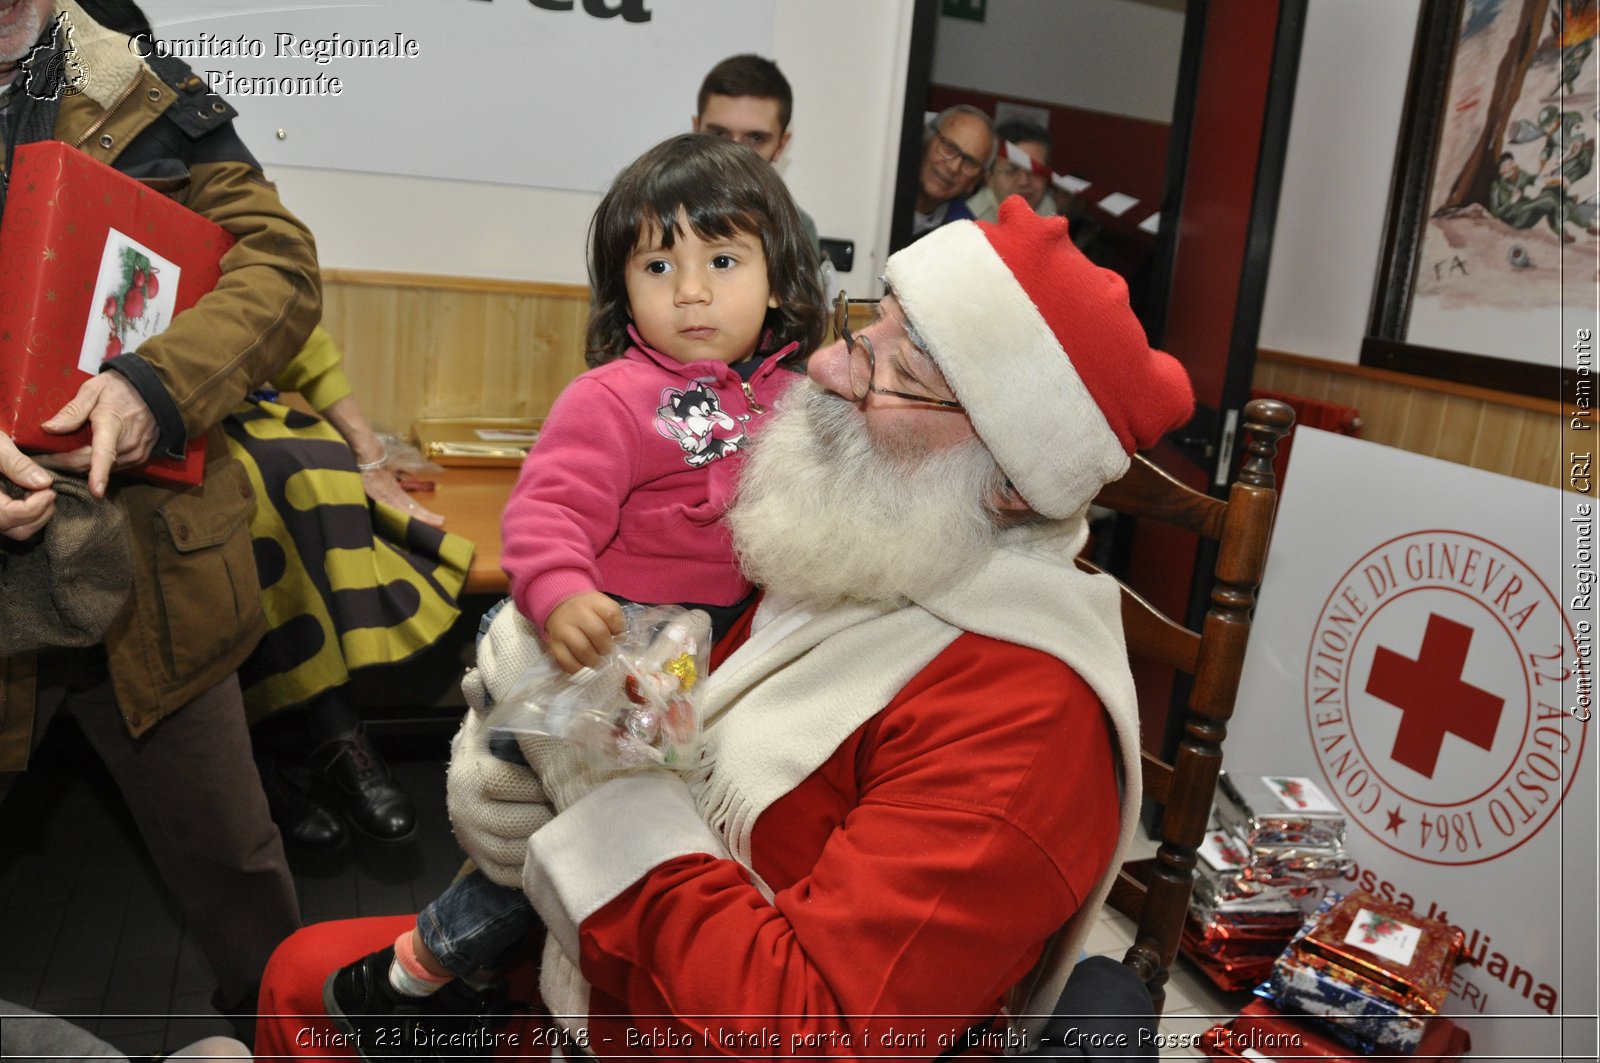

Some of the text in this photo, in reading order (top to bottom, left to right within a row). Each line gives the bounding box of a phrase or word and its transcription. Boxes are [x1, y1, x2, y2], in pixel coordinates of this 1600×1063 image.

[1314, 542, 1573, 853] CONVENZIONE DI GINEVRA 22 AGOSTO 1864
